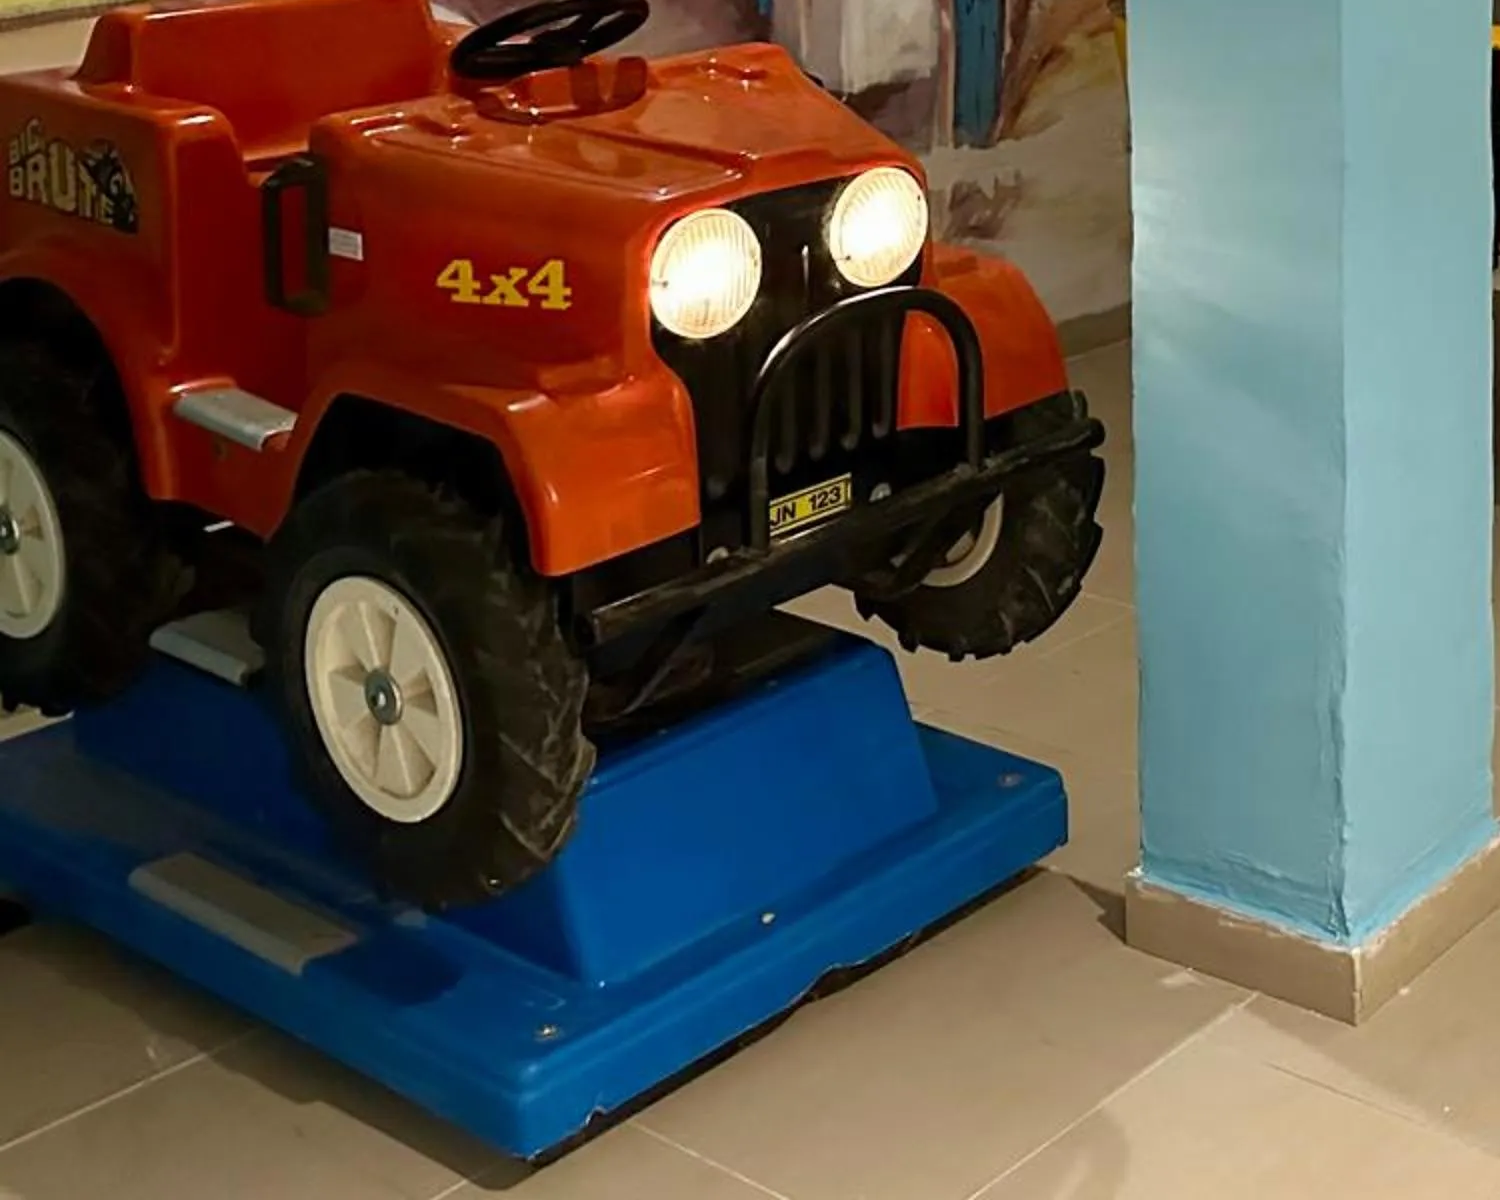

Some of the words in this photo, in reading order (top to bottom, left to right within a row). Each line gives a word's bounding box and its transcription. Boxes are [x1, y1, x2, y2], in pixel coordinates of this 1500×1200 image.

[8, 117, 40, 166] BIG
[8, 140, 116, 225] BRUTE
[435, 258, 573, 311] 4x4
[809, 485, 842, 511] 123
